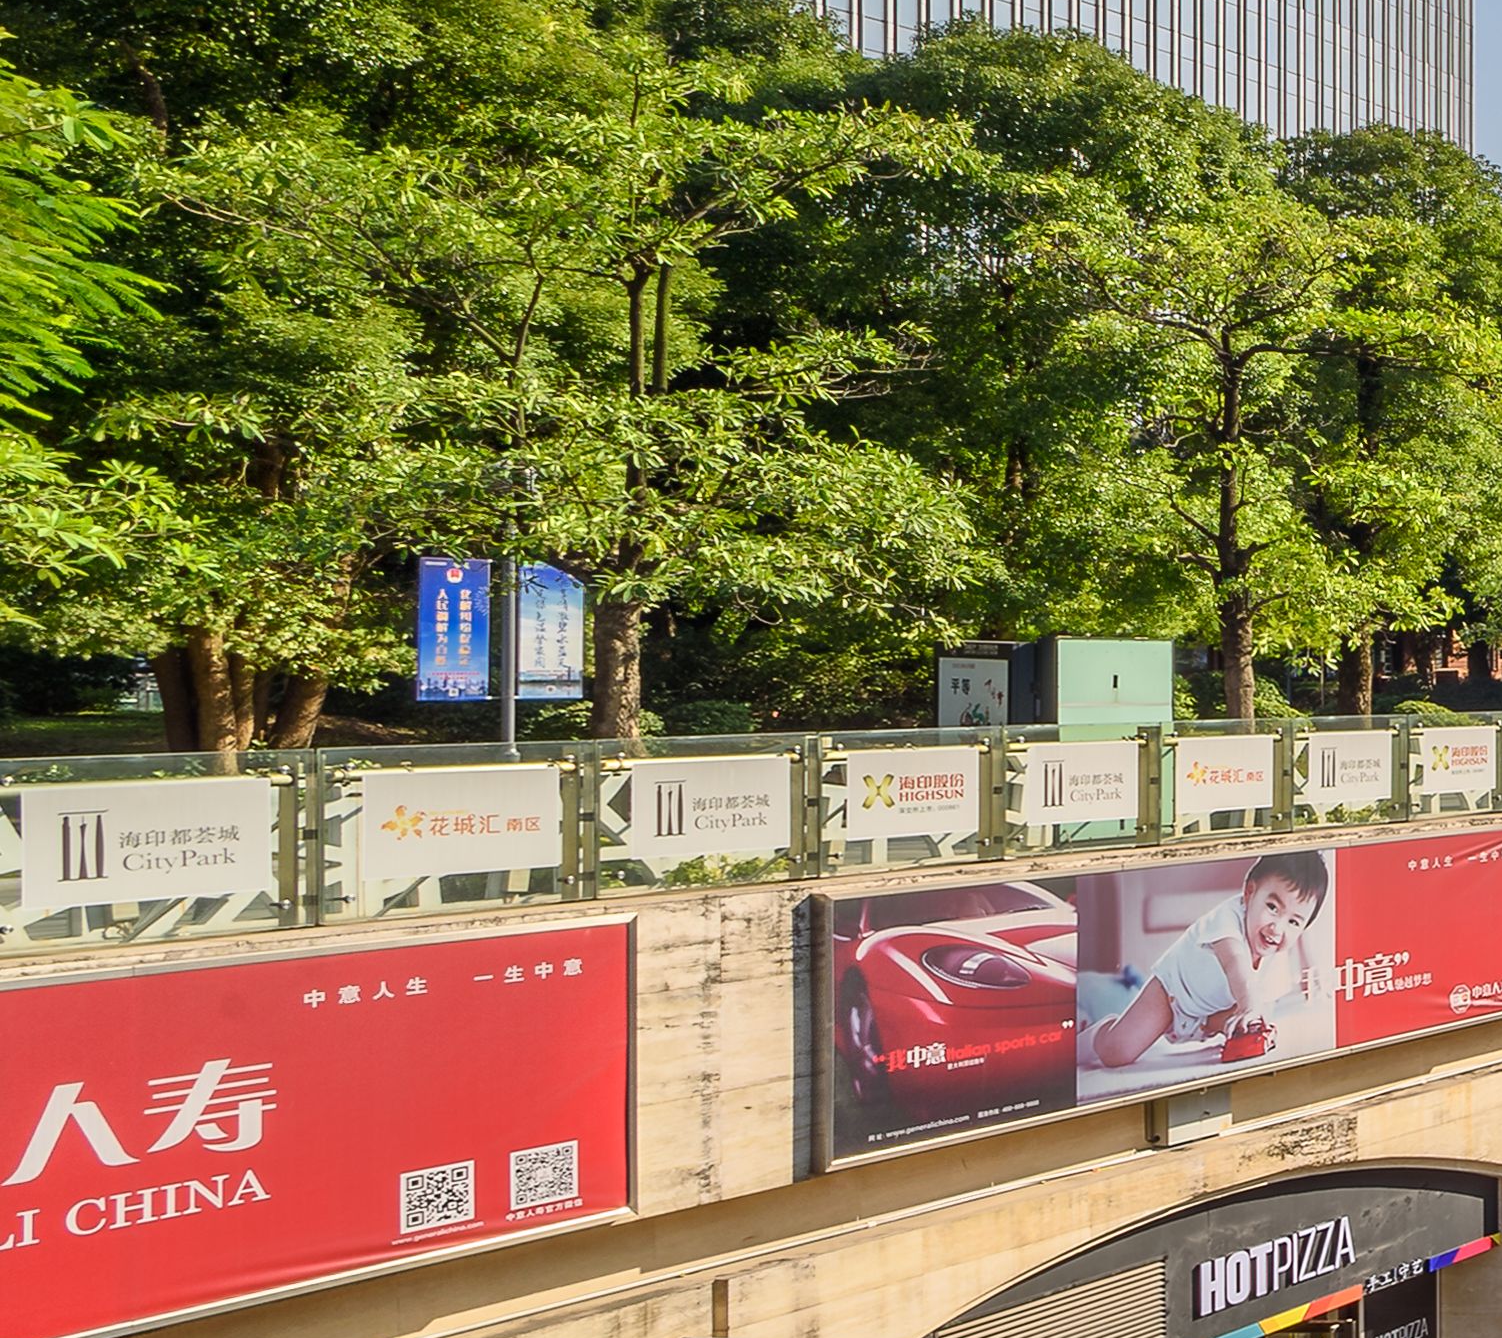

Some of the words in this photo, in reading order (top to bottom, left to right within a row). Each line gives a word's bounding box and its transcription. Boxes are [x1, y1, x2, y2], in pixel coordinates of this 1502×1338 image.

[899, 772, 965, 791] 海印股份
[692, 793, 771, 813] 海印都荟城
[899, 788, 965, 803] HIGHSUN
[429, 813, 501, 837] 花城汇
[506, 816, 542, 834] 南区
[694, 811, 768, 833] CityPark
[118, 824, 241, 849] 海印都荟城
[122, 847, 237, 875] CityPark
[1408, 856, 1454, 871] 中意人生
[303, 977, 428, 1008] 中意人生
[474, 958, 583, 984] 一生中意
[994, 1032, 1036, 1055] sports
[2, 1058, 278, 1187] 人寿
[66, 1168, 271, 1236] CHINA
